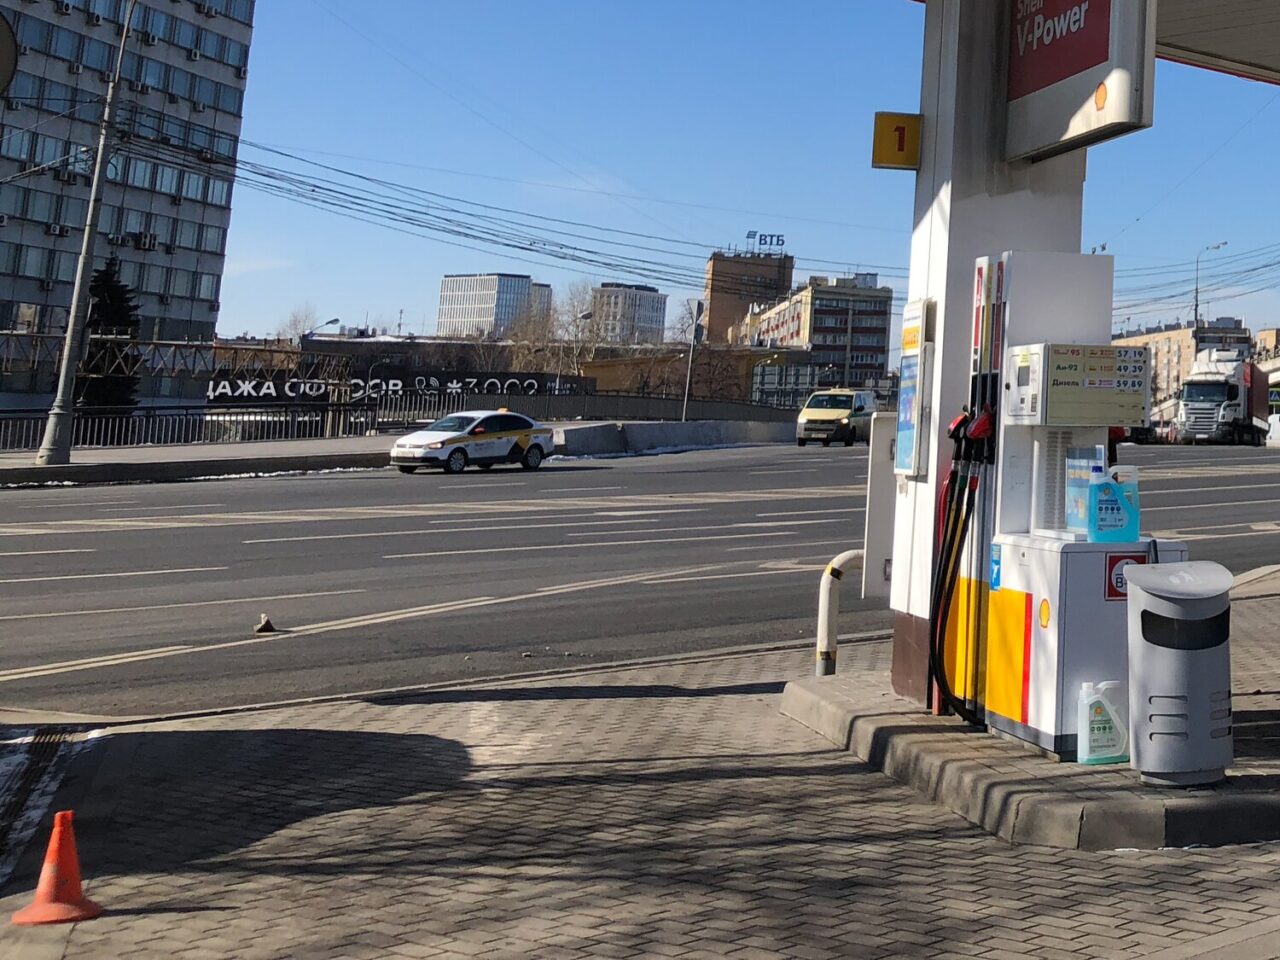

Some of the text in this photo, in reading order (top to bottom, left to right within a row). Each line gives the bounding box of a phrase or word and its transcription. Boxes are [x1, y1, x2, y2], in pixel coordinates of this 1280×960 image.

[1016, 0, 1089, 56] V-Power
[894, 126, 906, 152] 1
[759, 234, 785, 246] ВТБ
[284, 379, 403, 397] ОФСОВ
